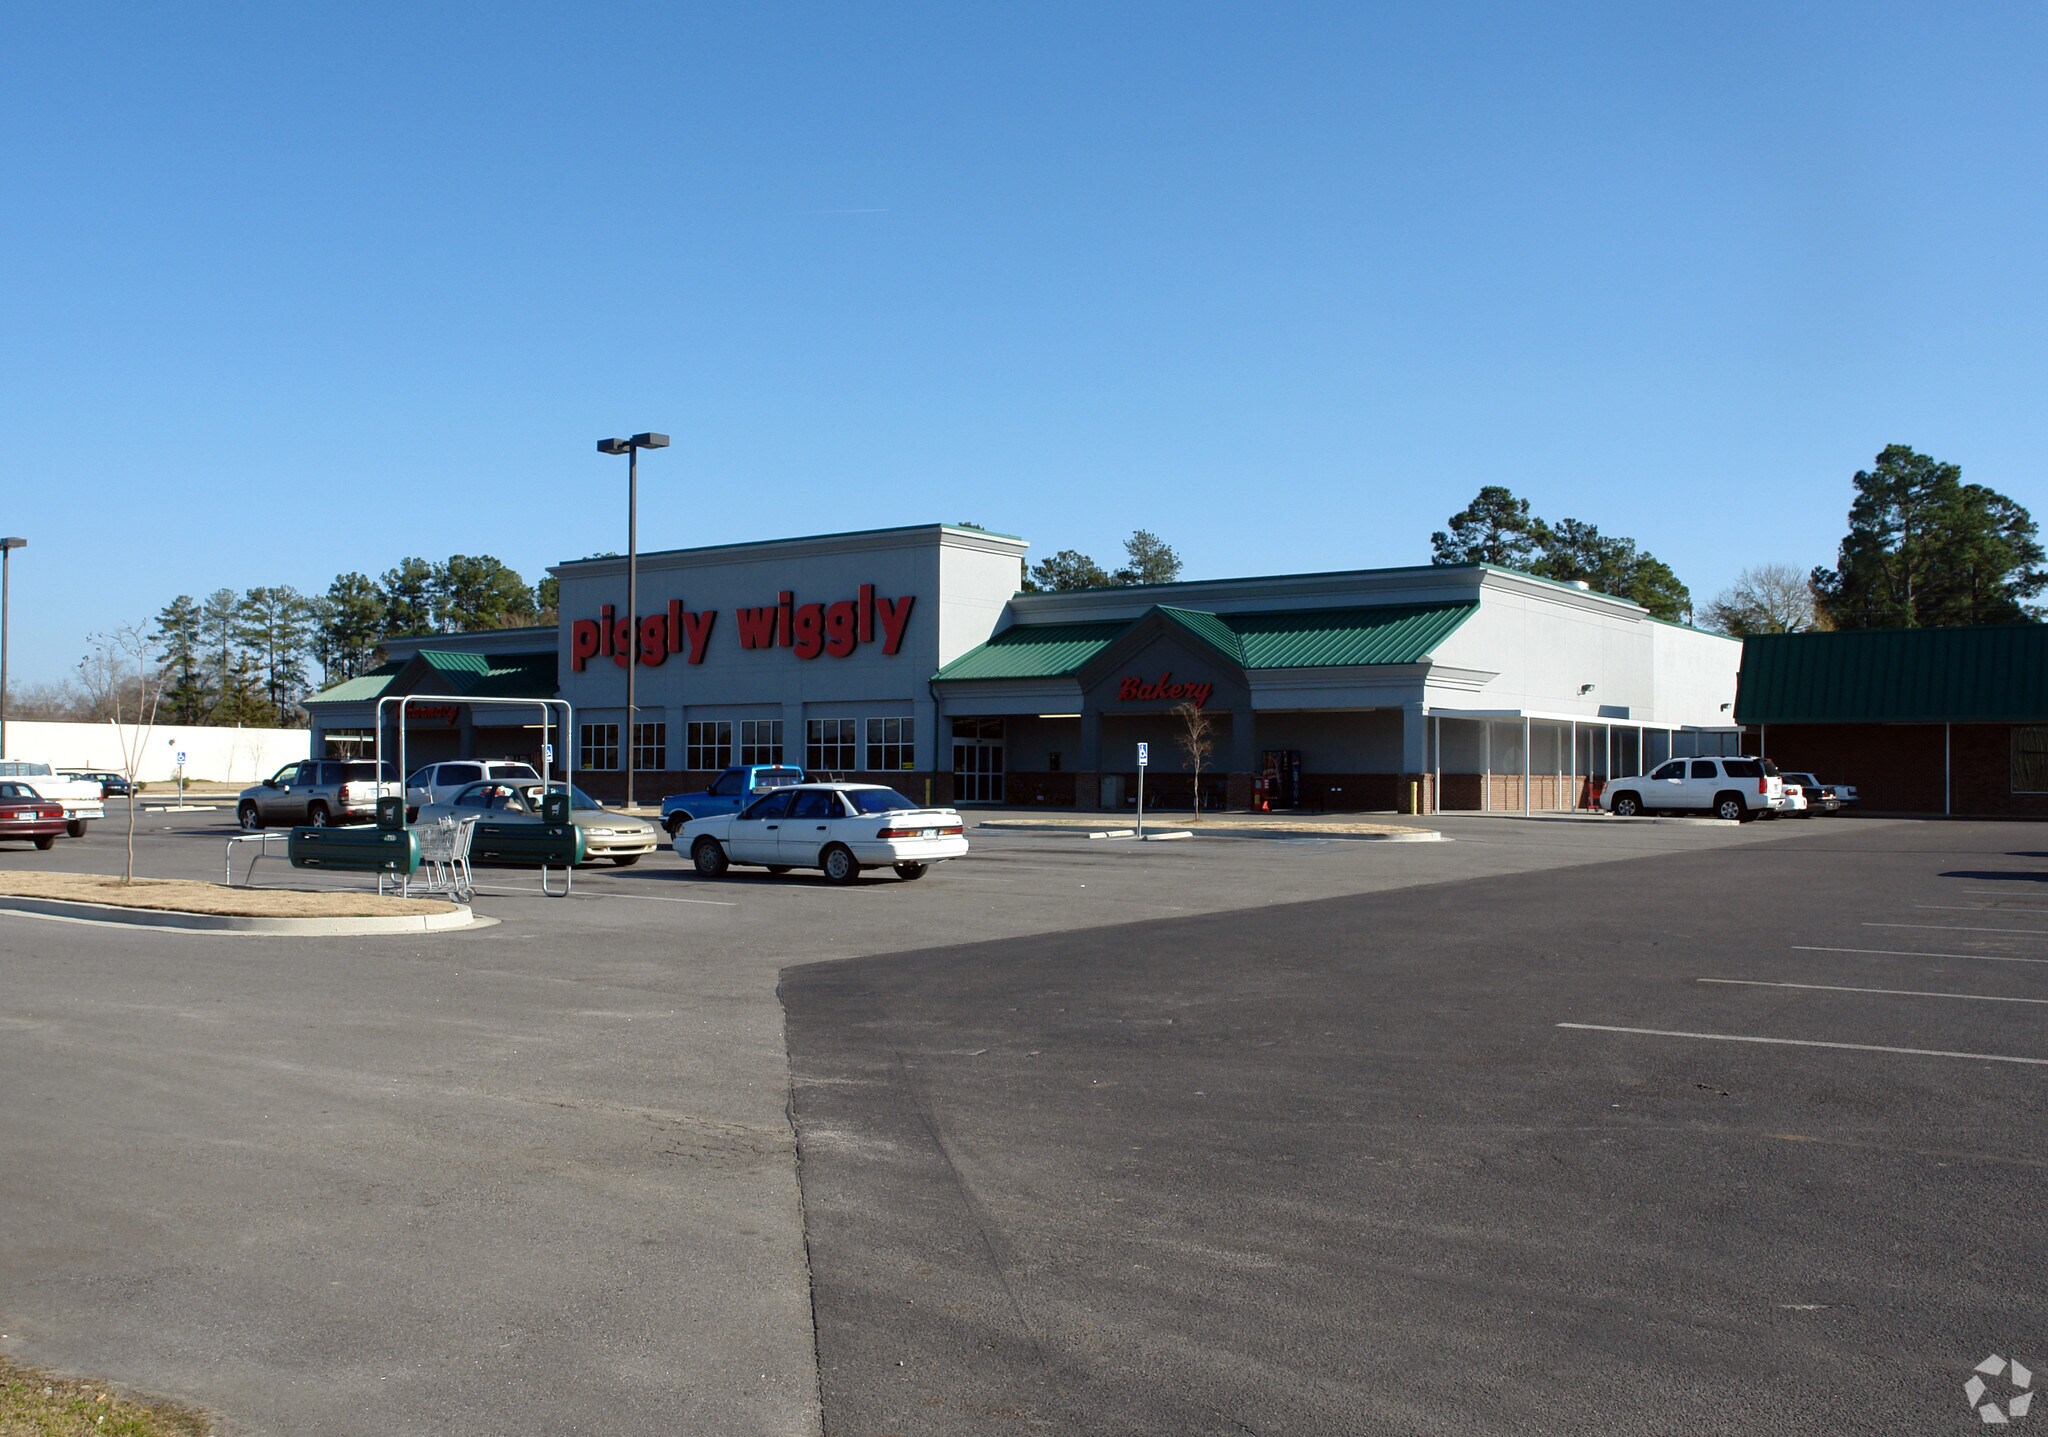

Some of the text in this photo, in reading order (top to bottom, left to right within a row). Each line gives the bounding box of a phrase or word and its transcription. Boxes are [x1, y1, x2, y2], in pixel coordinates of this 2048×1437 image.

[571, 583, 915, 673] piggly wiggly
[1117, 671, 1213, 709] Bakery
